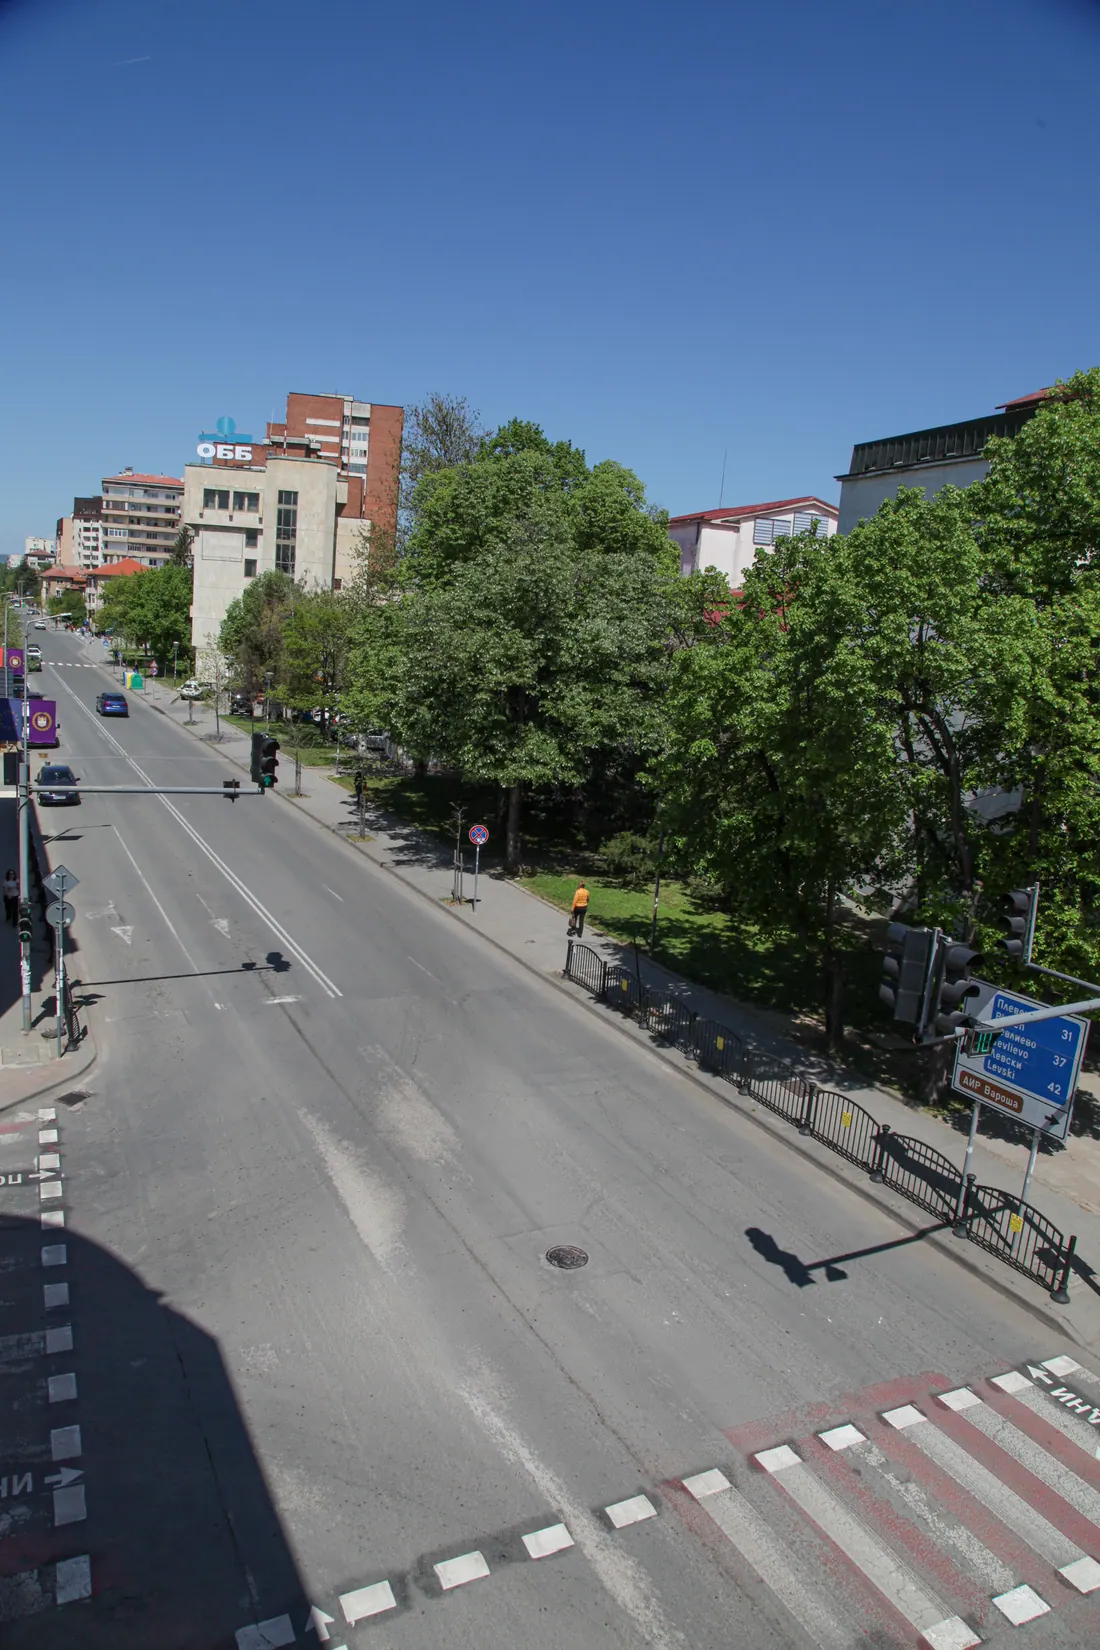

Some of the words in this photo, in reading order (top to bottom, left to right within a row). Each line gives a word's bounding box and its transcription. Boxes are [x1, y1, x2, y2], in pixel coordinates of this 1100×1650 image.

[197, 443, 252, 461] ОББ
[1061, 1029, 1072, 1042] 31
[1053, 1055, 1067, 1068] 37
[987, 1060, 1016, 1080] Levski
[962, 1076, 981, 1090] АИР
[984, 1085, 1019, 1109] Вароша
[1047, 1082, 1062, 1096] 42
